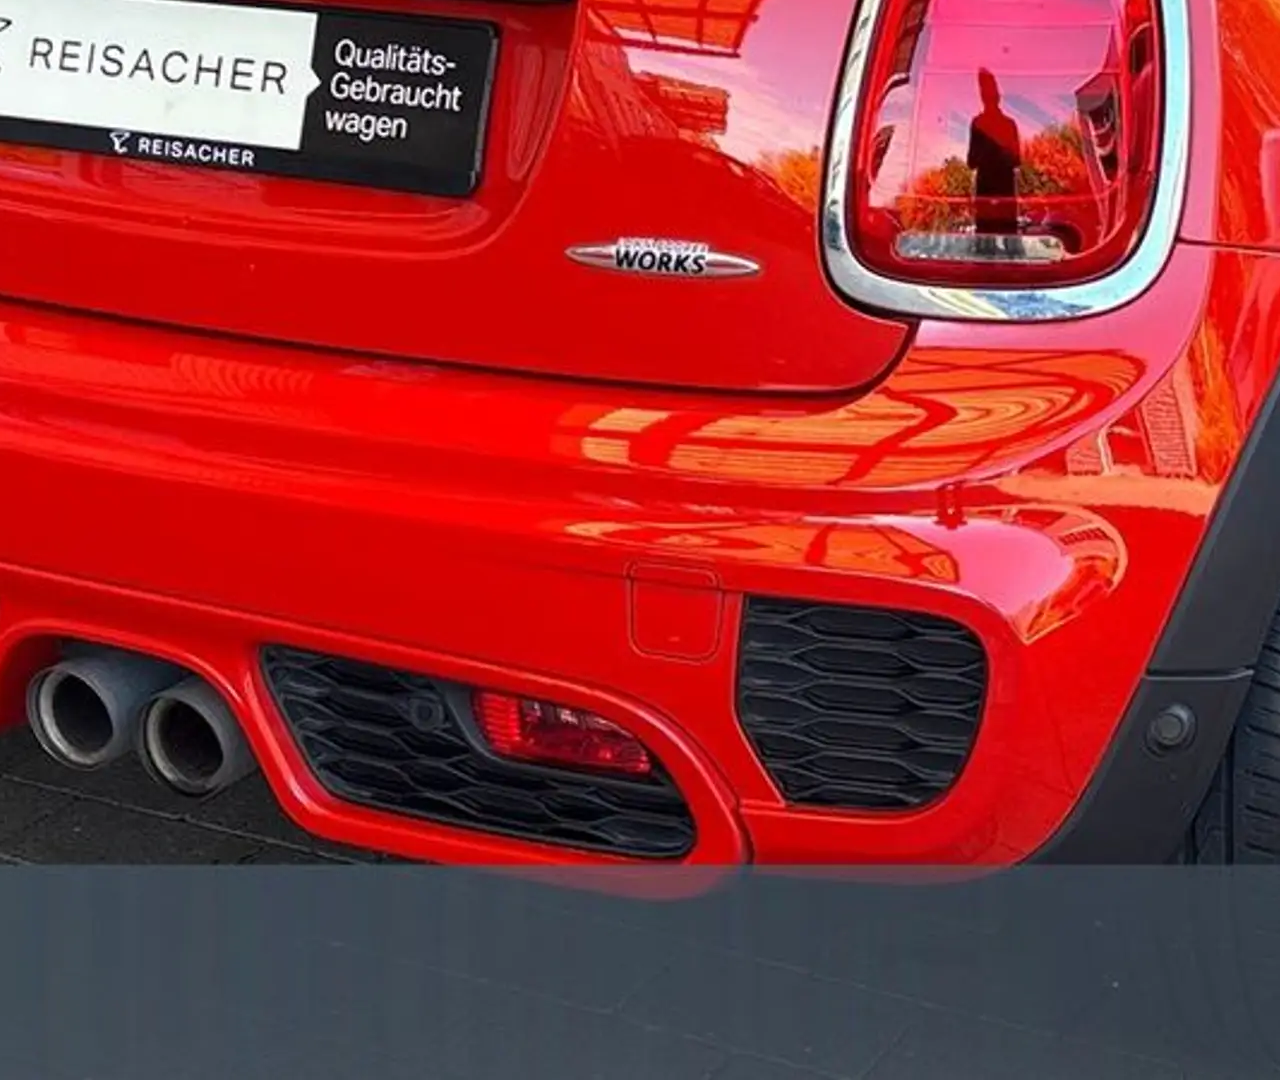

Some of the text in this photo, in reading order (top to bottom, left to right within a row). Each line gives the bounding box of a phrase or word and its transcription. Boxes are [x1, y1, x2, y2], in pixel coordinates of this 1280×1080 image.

[28, 37, 288, 94] REISACHER
[334, 38, 457, 76] Qualitäts-
[329, 72, 463, 111] Gebraucht
[324, 108, 408, 140] wagen
[137, 137, 255, 167] REISACHER
[615, 248, 707, 274] WORKS
